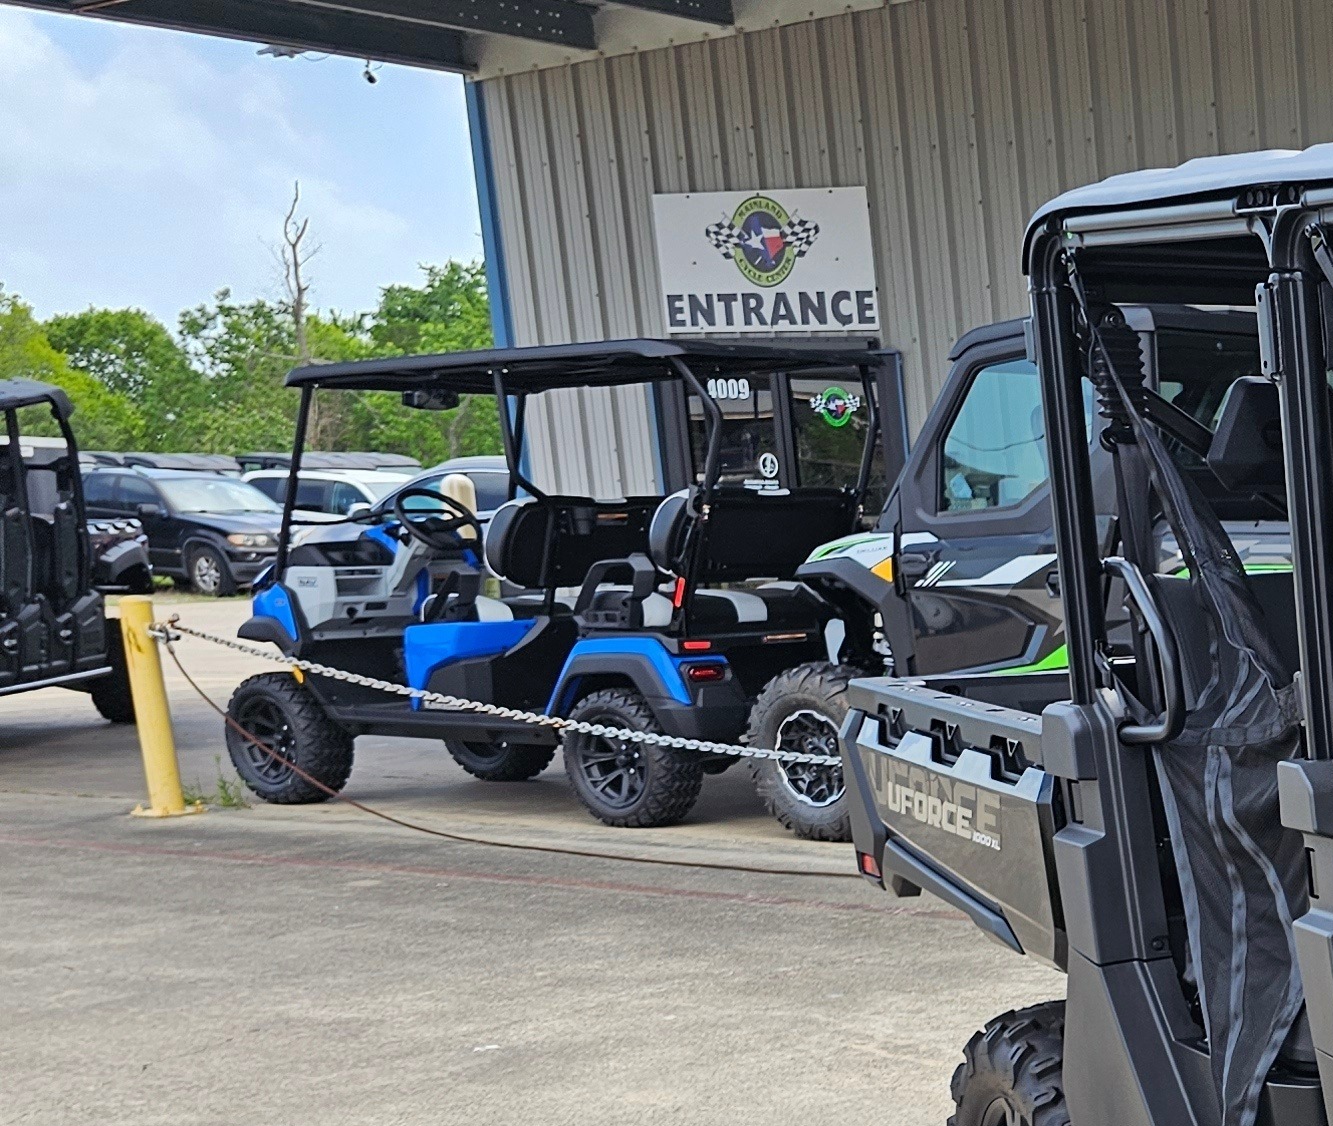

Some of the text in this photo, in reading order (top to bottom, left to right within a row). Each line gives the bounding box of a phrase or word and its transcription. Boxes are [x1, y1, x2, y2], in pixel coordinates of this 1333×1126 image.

[738, 200, 783, 219] MAINLAND
[667, 290, 876, 328] ENTRANCE
[707, 378, 750, 400] 4009
[888, 781, 973, 840] UFORCE
